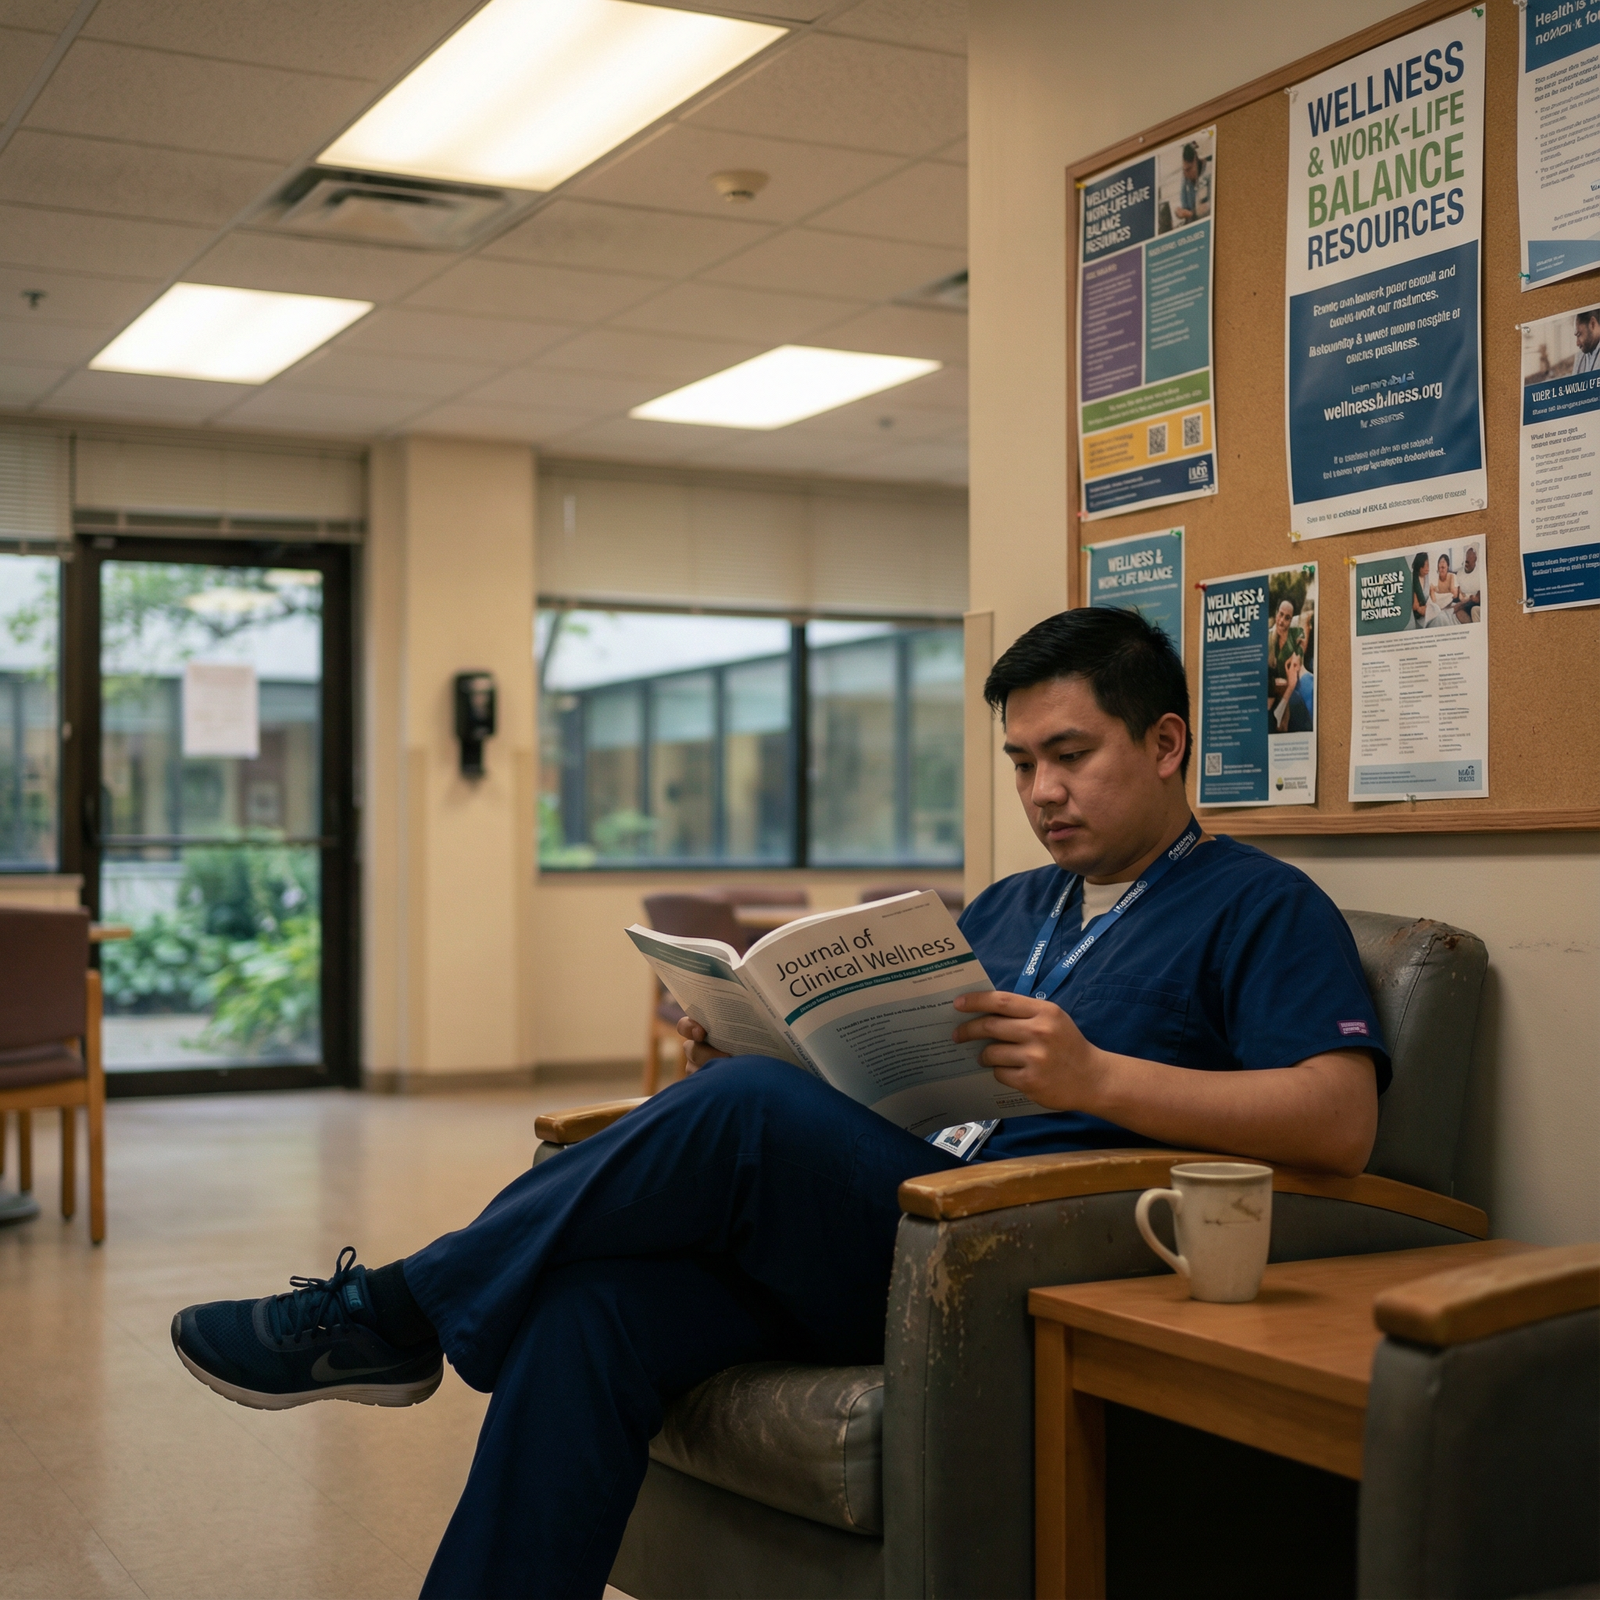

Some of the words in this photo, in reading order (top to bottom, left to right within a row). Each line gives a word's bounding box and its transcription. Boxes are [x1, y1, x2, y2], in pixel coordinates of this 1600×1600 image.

[1535, 2, 1573, 27] Health
[1308, 40, 1465, 137] WELLNESS
[1308, 147, 1324, 178] &
[1330, 89, 1464, 170] WORK-LIFE
[1309, 131, 1464, 228] BALANCE
[1308, 187, 1464, 270] RESOURCES
[1438, 264, 1456, 280] and
[1207, 589, 1257, 610] WELLNESS
[1257, 587, 1265, 603] &
[1207, 605, 1260, 627] WORK-LIFE
[1207, 622, 1250, 643] BALANCE
[776, 935, 850, 981] Journal
[853, 928, 874, 949] of
[789, 956, 864, 998] Clinical
[862, 936, 956, 970] Wellness
